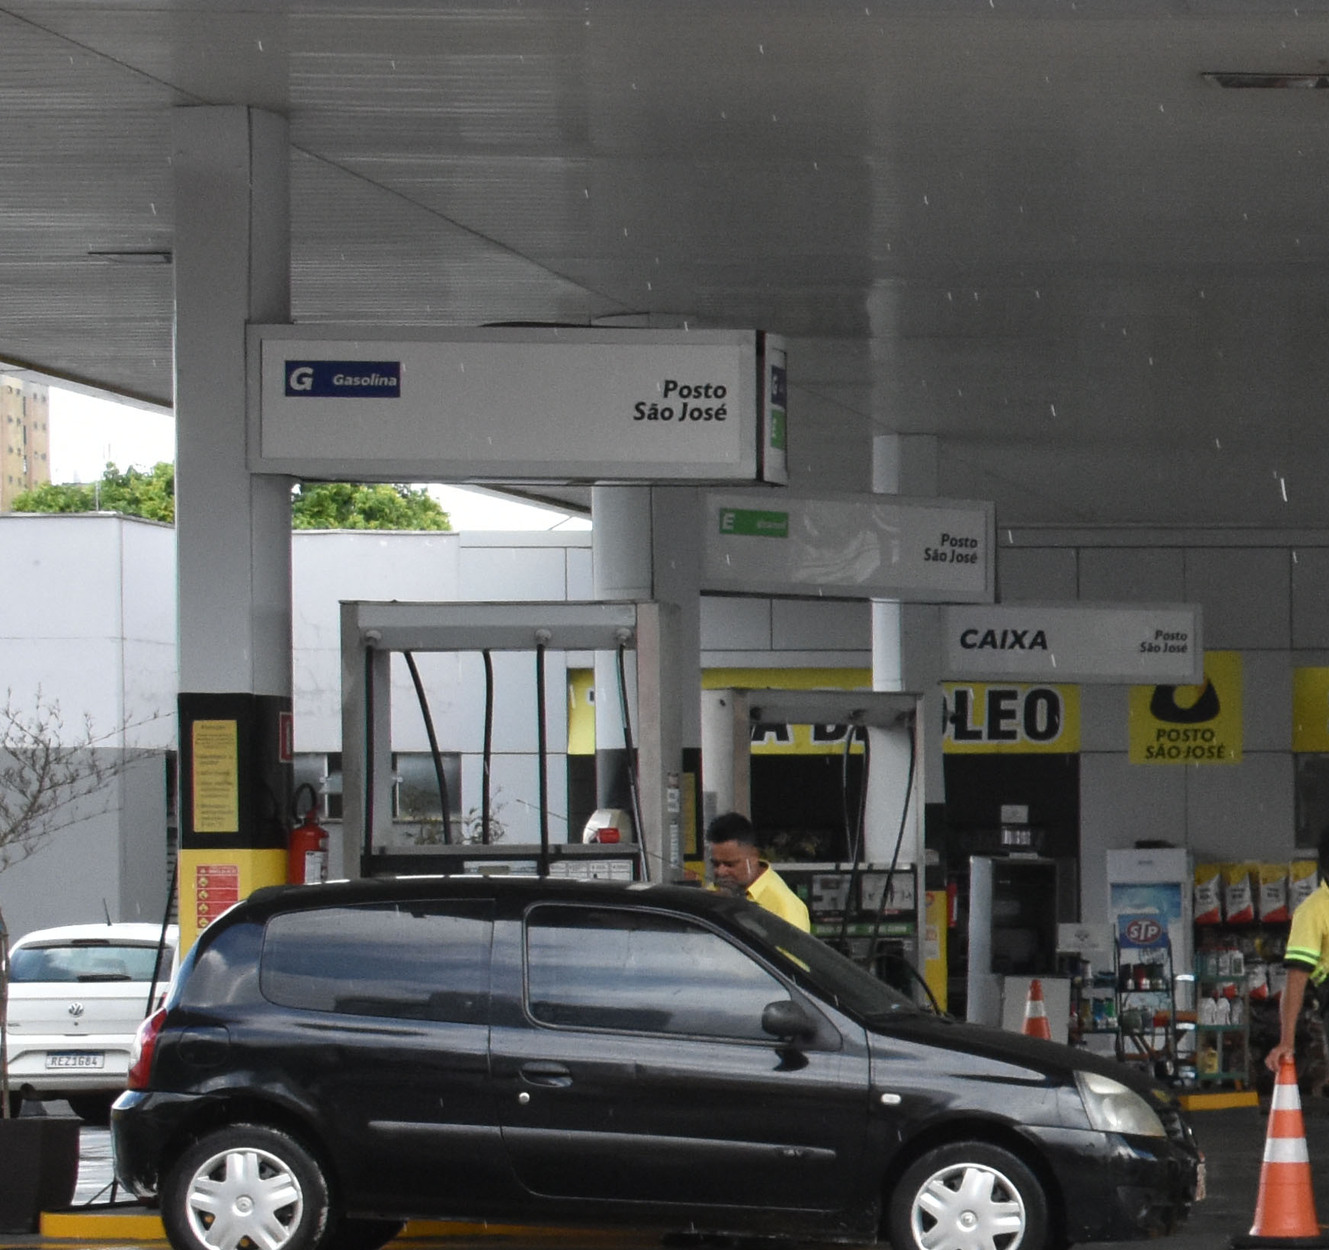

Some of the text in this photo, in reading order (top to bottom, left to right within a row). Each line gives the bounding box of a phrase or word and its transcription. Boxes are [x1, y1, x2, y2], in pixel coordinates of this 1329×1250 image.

[290, 367, 397, 391] G Gasolina
[663, 380, 727, 399] Posto
[633, 402, 727, 422] São José
[941, 533, 978, 549] Posto
[924, 548, 978, 563] São José
[960, 629, 1048, 650] CAIXA
[1155, 630, 1188, 641] Posto
[1163, 642, 1188, 654] José
[941, 689, 1060, 741] LEO
[1156, 728, 1215, 743] POSTO
[1146, 744, 1225, 760] SÃO JOSÉ
[1129, 921, 1159, 942] STP
